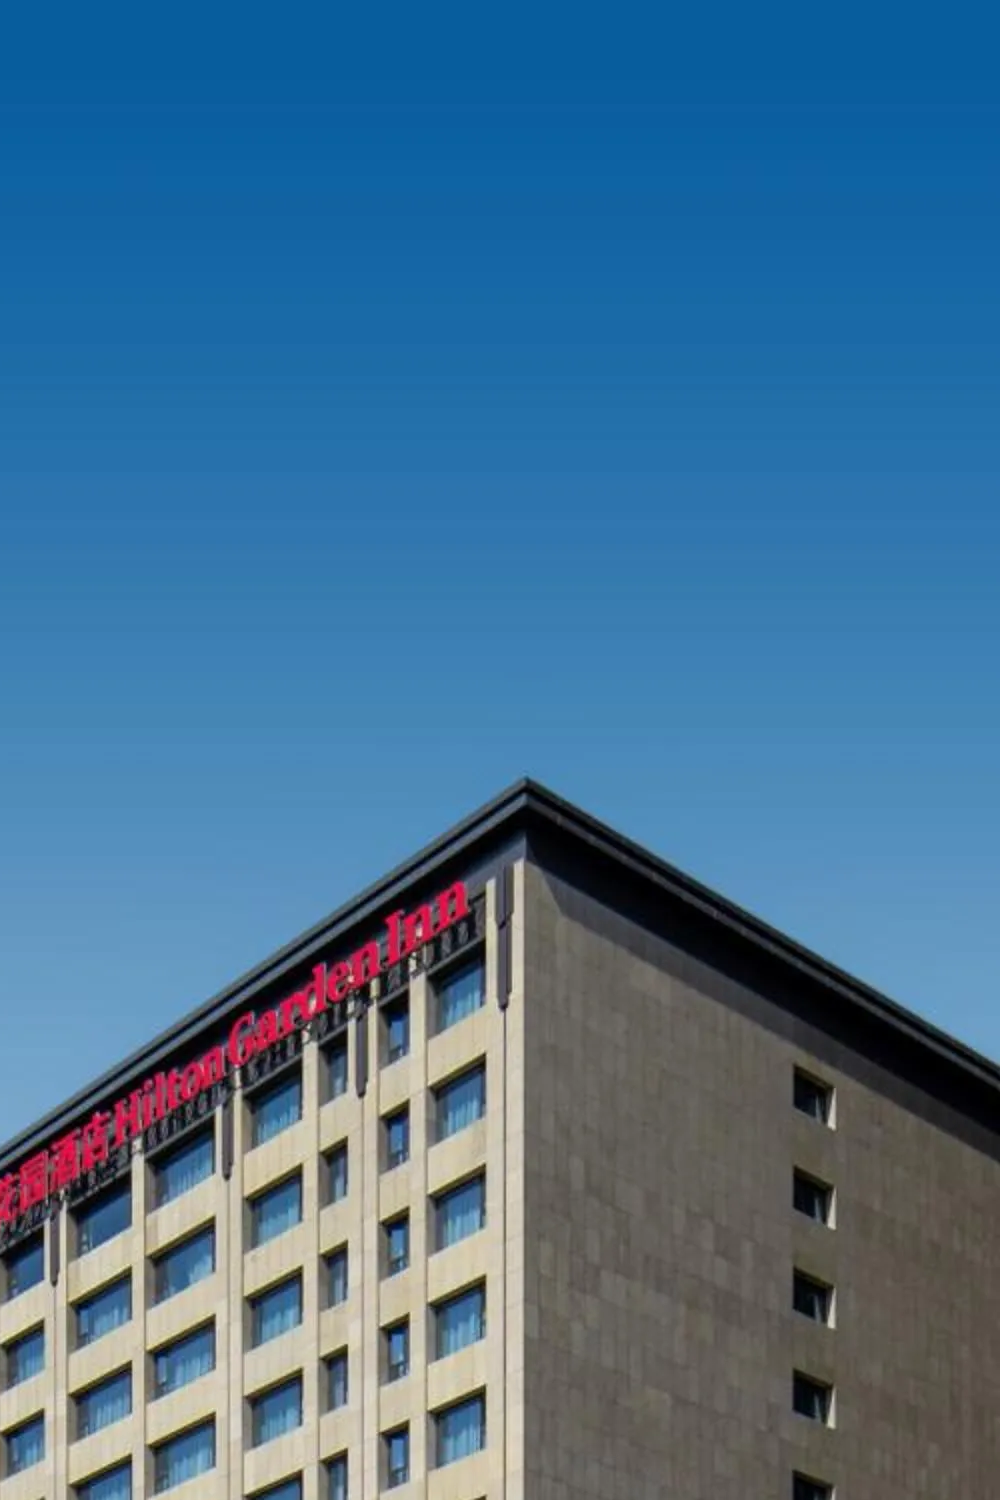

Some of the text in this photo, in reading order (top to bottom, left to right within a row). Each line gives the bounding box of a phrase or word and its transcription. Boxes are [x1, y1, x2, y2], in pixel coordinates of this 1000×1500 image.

[113, 881, 469, 1147] Hilton Garden Inn
